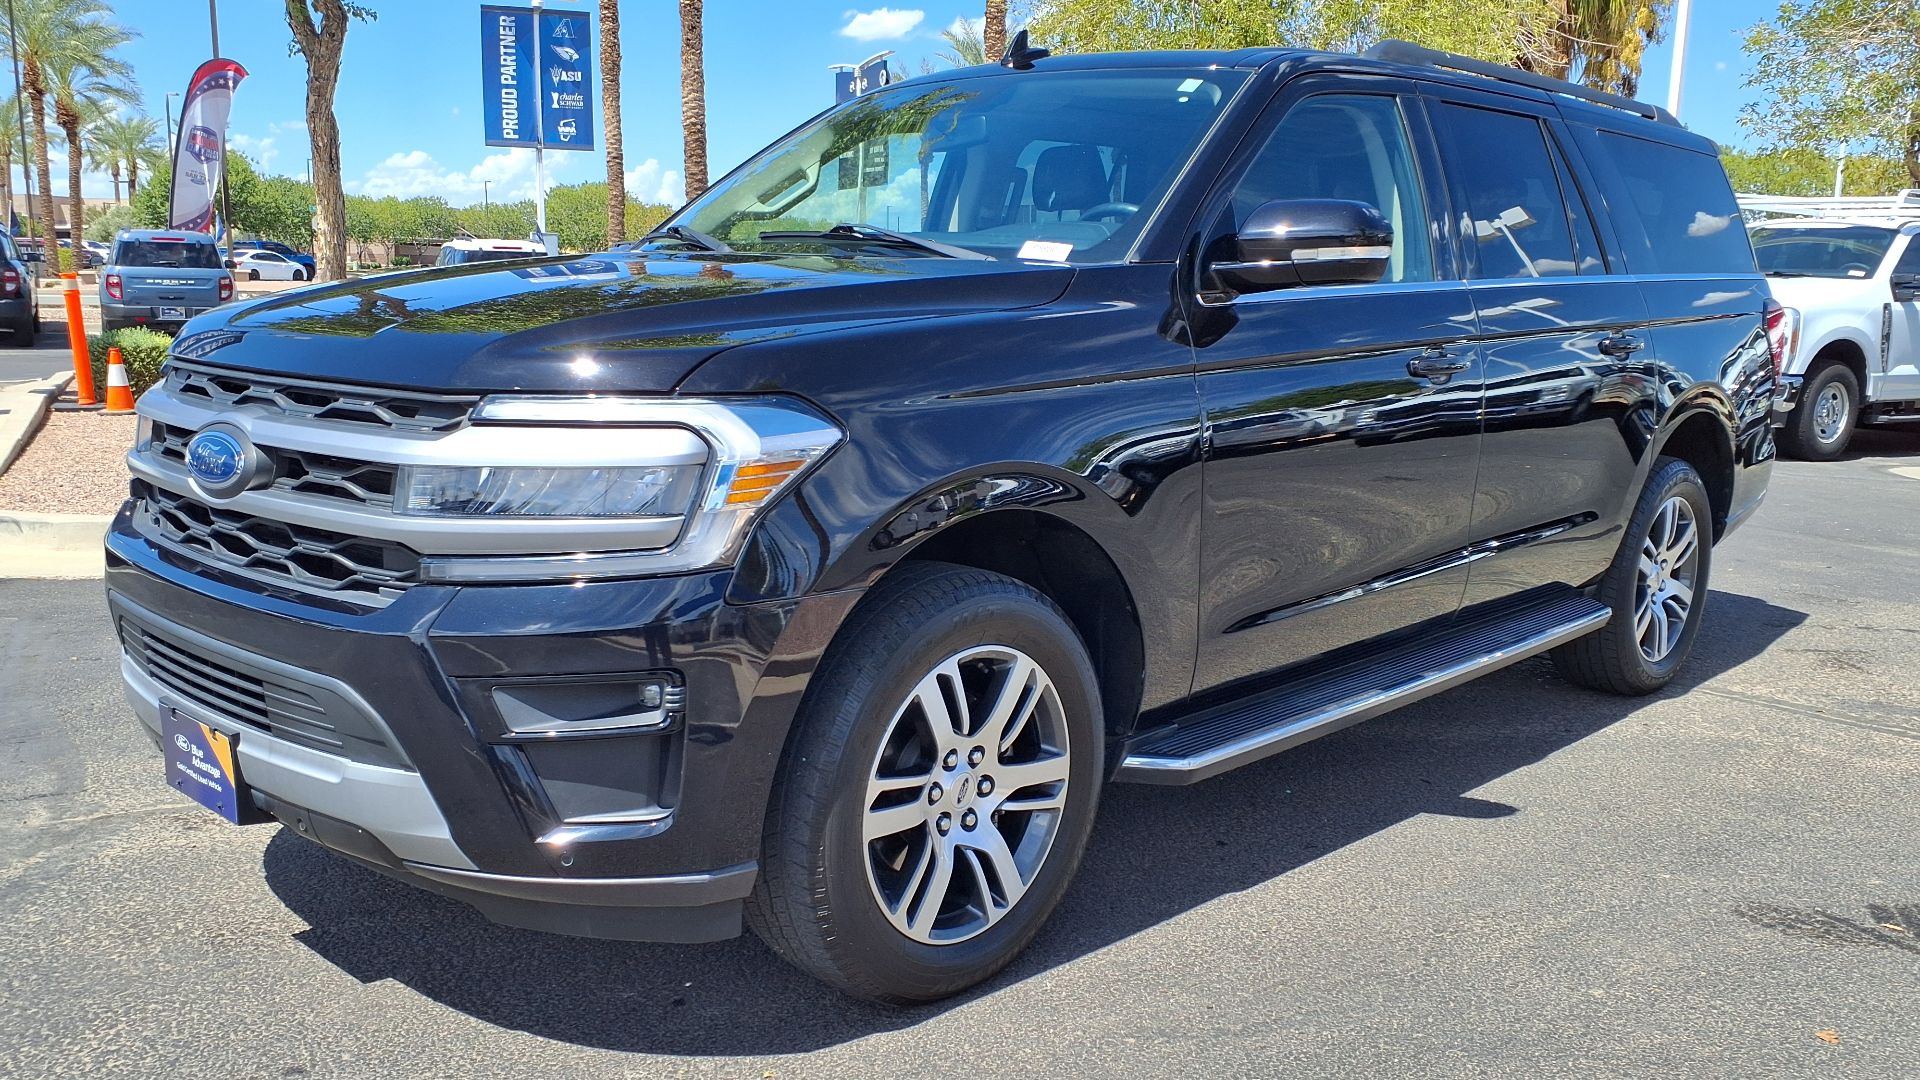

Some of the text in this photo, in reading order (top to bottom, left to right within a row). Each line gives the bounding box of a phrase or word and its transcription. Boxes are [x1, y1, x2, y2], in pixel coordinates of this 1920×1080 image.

[499, 15, 519, 138] PROUD PARTNER
[560, 71, 582, 82] ASU
[191, 744, 204, 758] Blue
[192, 756, 221, 778] Advantage
[207, 779, 223, 793] Vehicle
